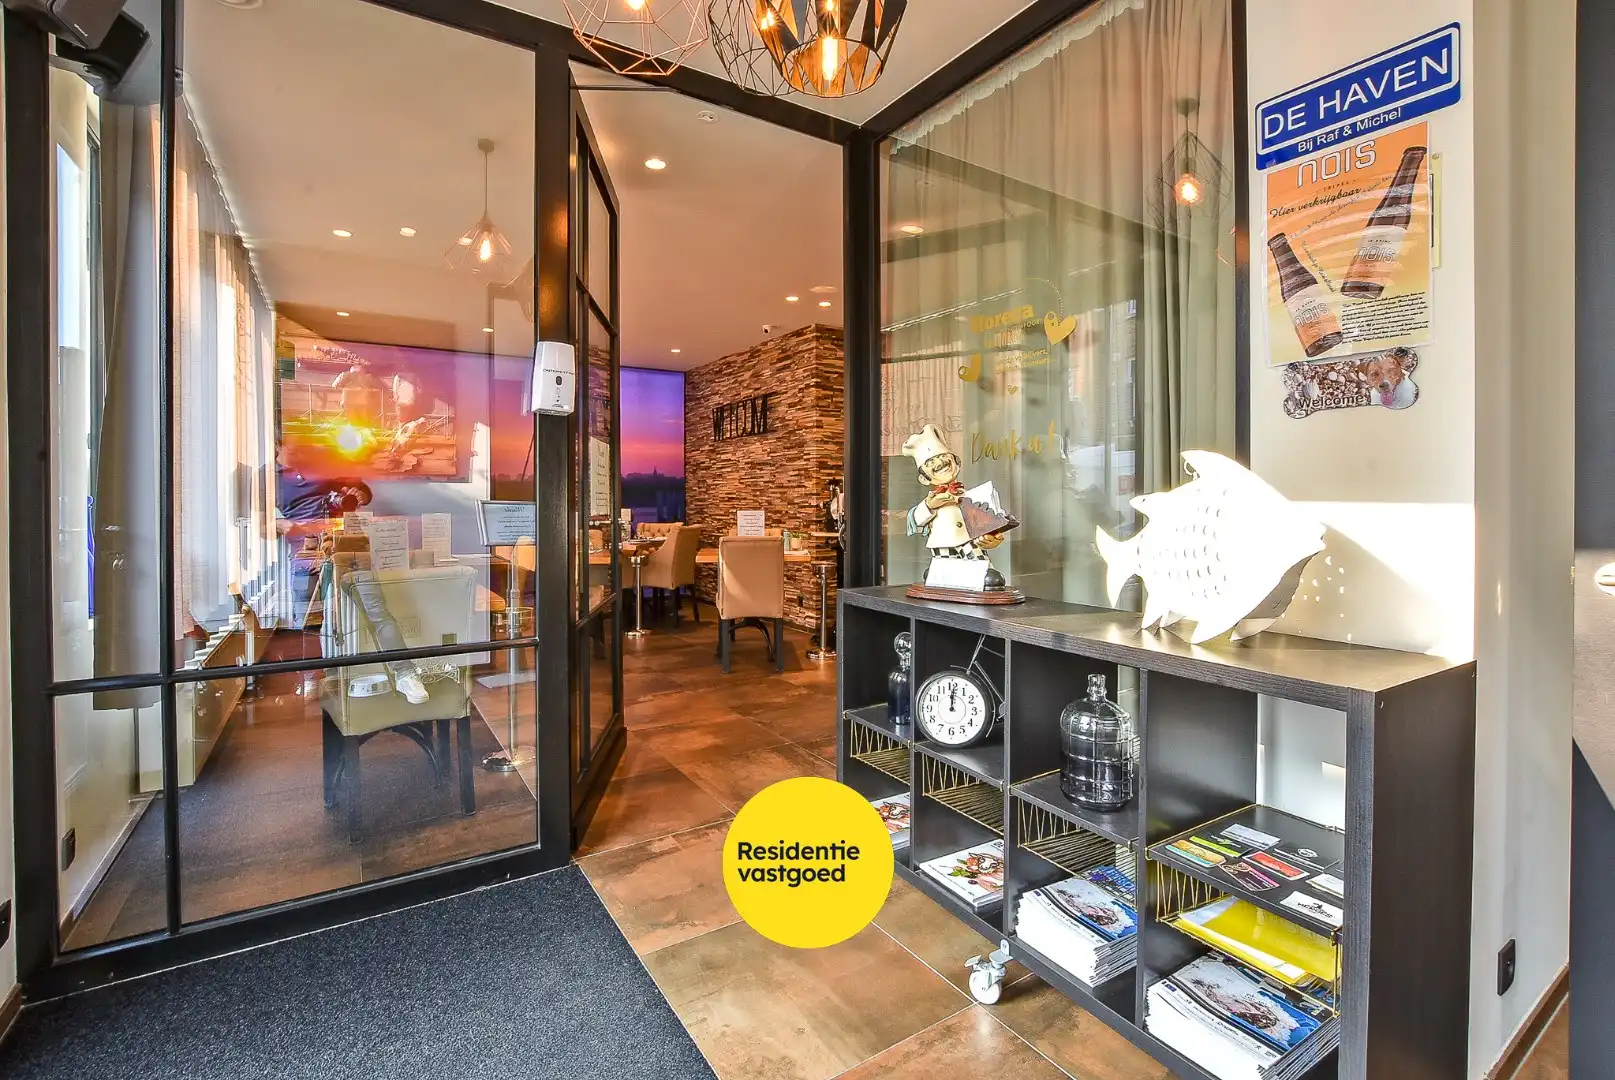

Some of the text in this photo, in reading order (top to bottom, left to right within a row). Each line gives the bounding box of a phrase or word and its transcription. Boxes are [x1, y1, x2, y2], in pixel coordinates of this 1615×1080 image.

[1263, 47, 1449, 140] DE HAVEN
[1298, 107, 1401, 153] Bij Raf & Michel
[1269, 206, 1297, 219] Hier
[1299, 186, 1363, 212] verkrijgbaar
[1299, 395, 1364, 408] Welcome
[968, 695, 974, 704] 2
[971, 707, 977, 716] 3
[967, 718, 973, 727] 4
[938, 724, 944, 732] 7
[948, 727, 955, 736] 6
[959, 725, 966, 734] 5
